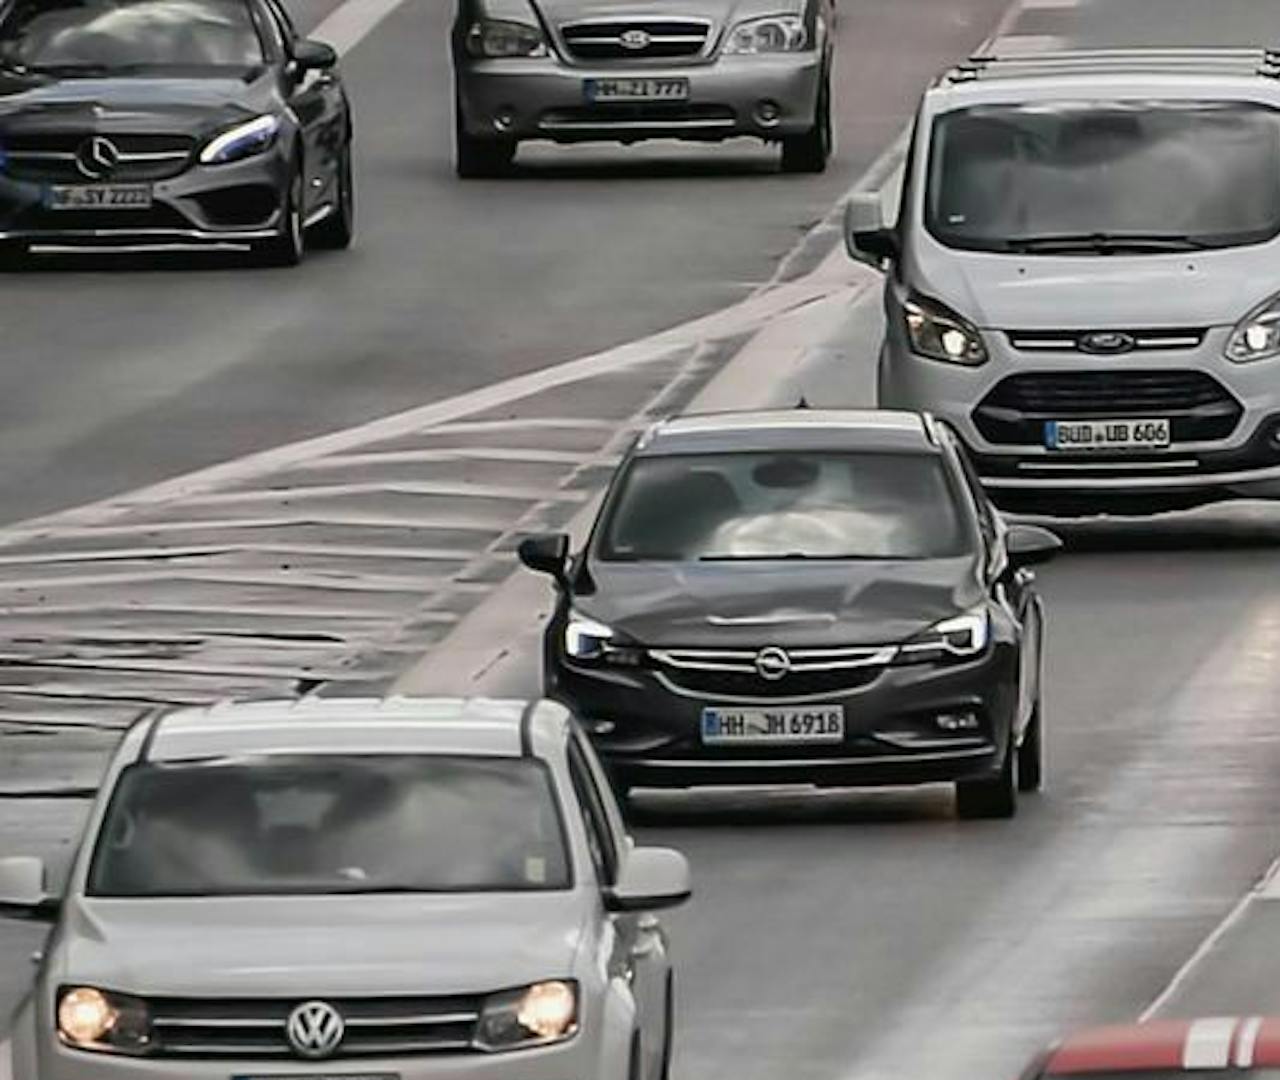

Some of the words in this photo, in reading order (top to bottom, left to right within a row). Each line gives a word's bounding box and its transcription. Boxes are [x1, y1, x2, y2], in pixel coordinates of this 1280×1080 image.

[1133, 422, 1167, 441] 606
[720, 715, 744, 736] HH
[789, 712, 840, 734] 6918
